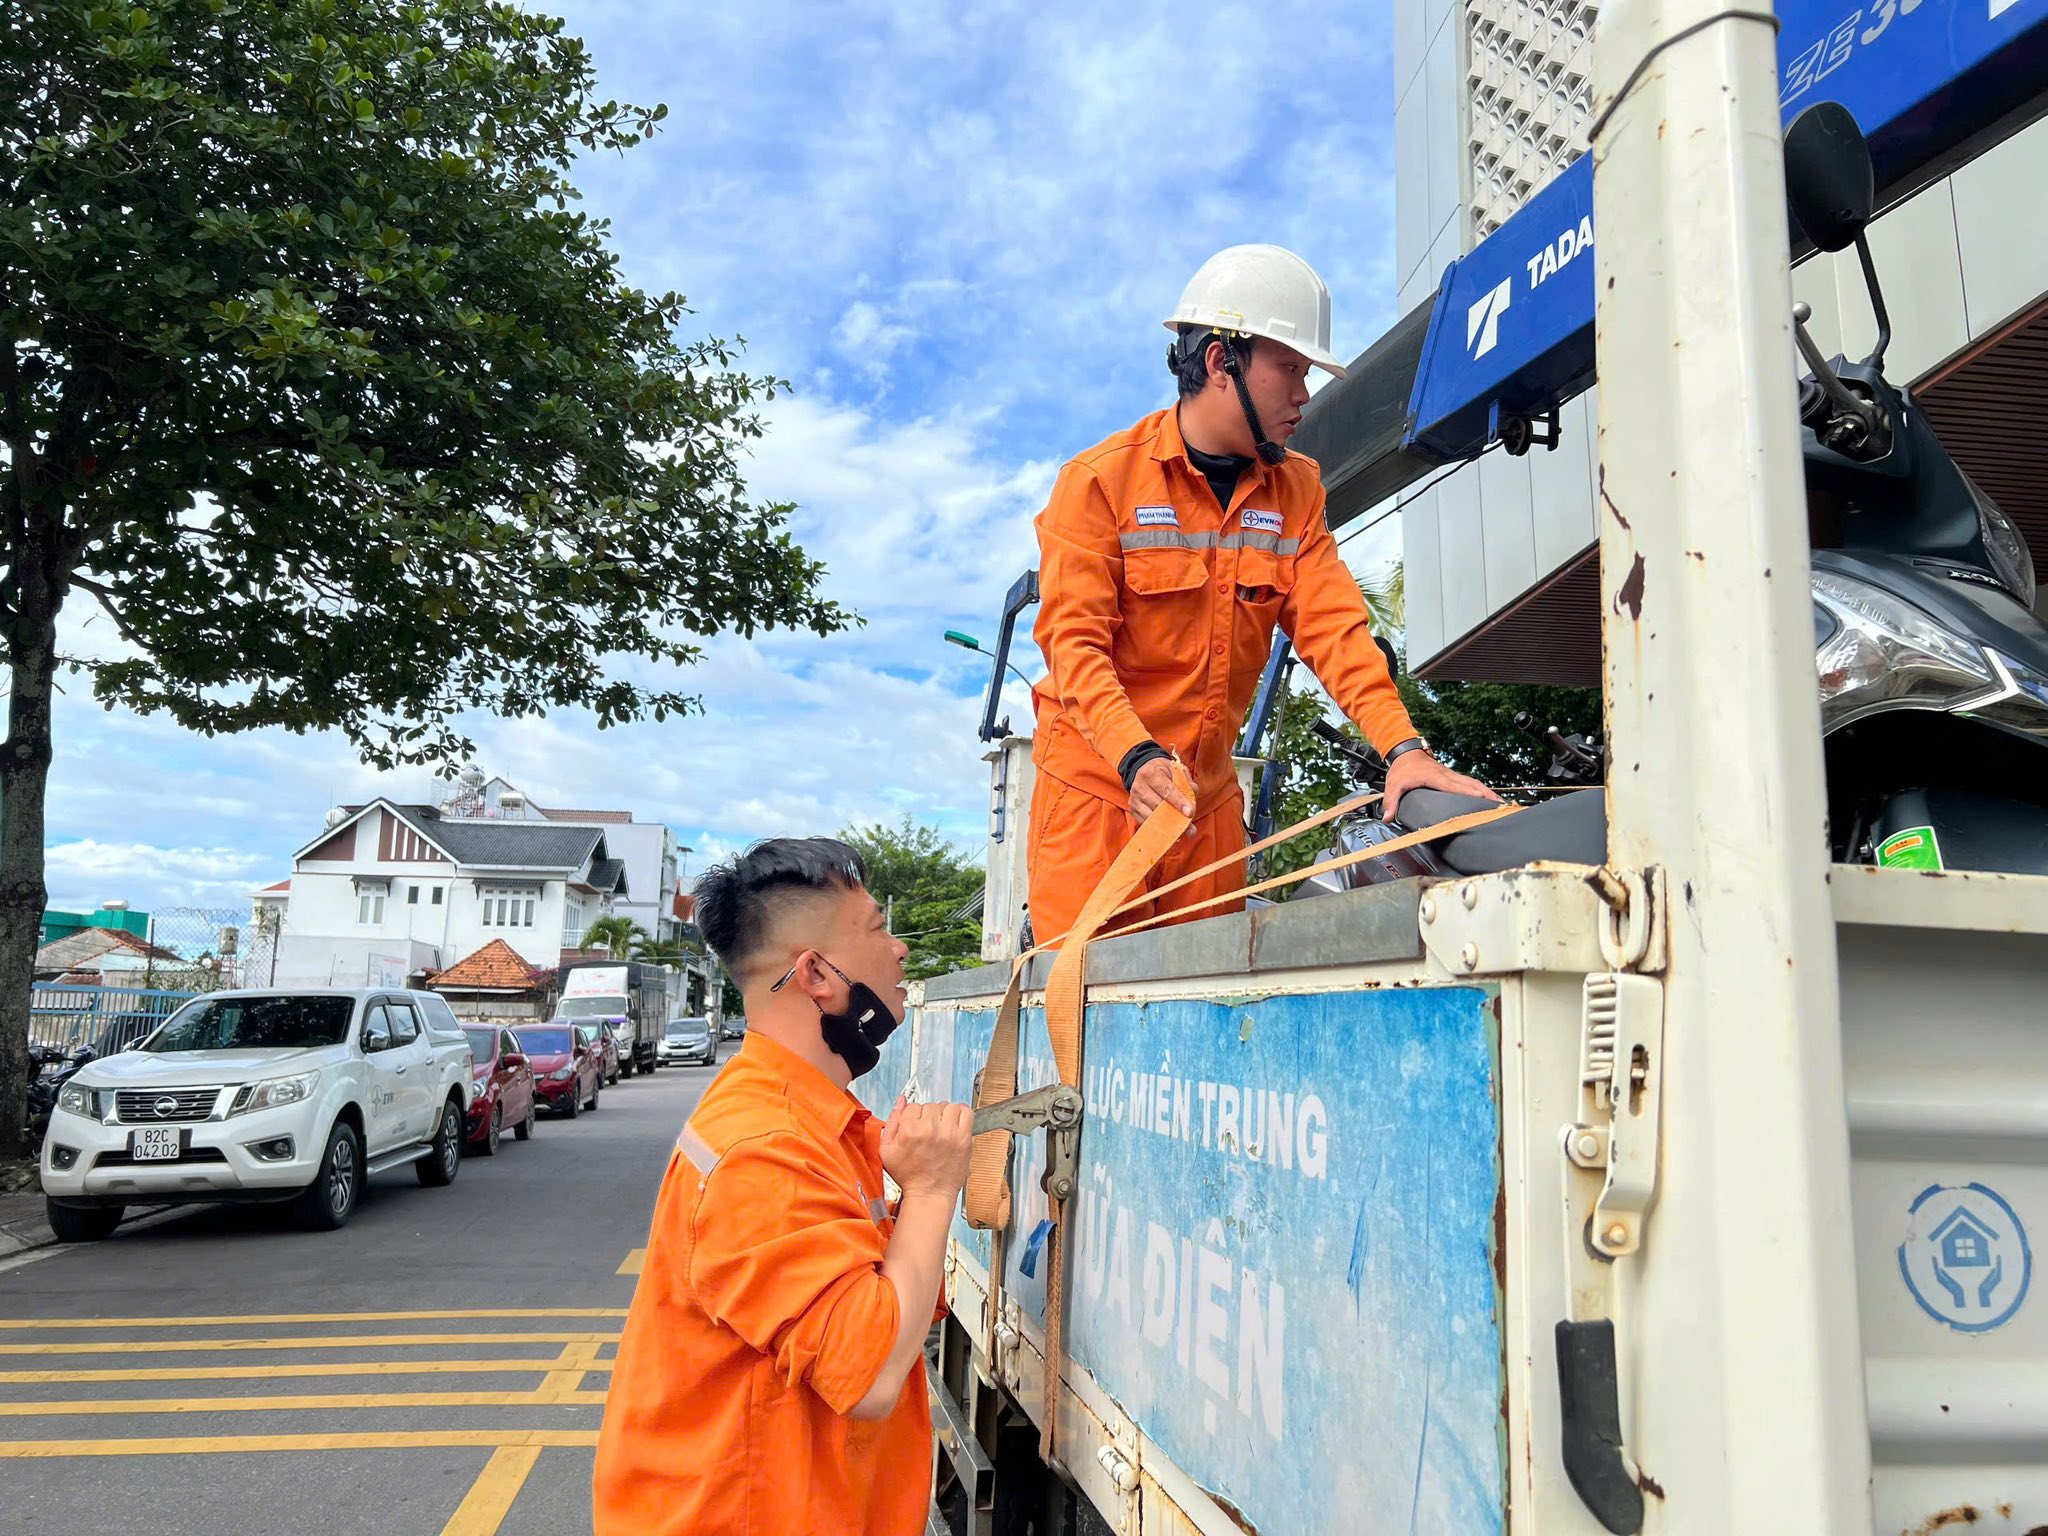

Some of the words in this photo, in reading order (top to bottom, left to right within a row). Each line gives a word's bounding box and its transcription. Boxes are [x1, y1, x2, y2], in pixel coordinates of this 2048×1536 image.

[1527, 214, 1594, 290] TADA
[135, 1143, 178, 1158] 042.02
[145, 1129, 169, 1143] 82C
[1087, 1056, 1124, 1134] LỰC
[1130, 1049, 1191, 1142] MIỀN
[1199, 1081, 1328, 1180] TRUNG
[1073, 1161, 1135, 1326] ỮA
[1143, 1217, 1286, 1442] ĐIỆN
